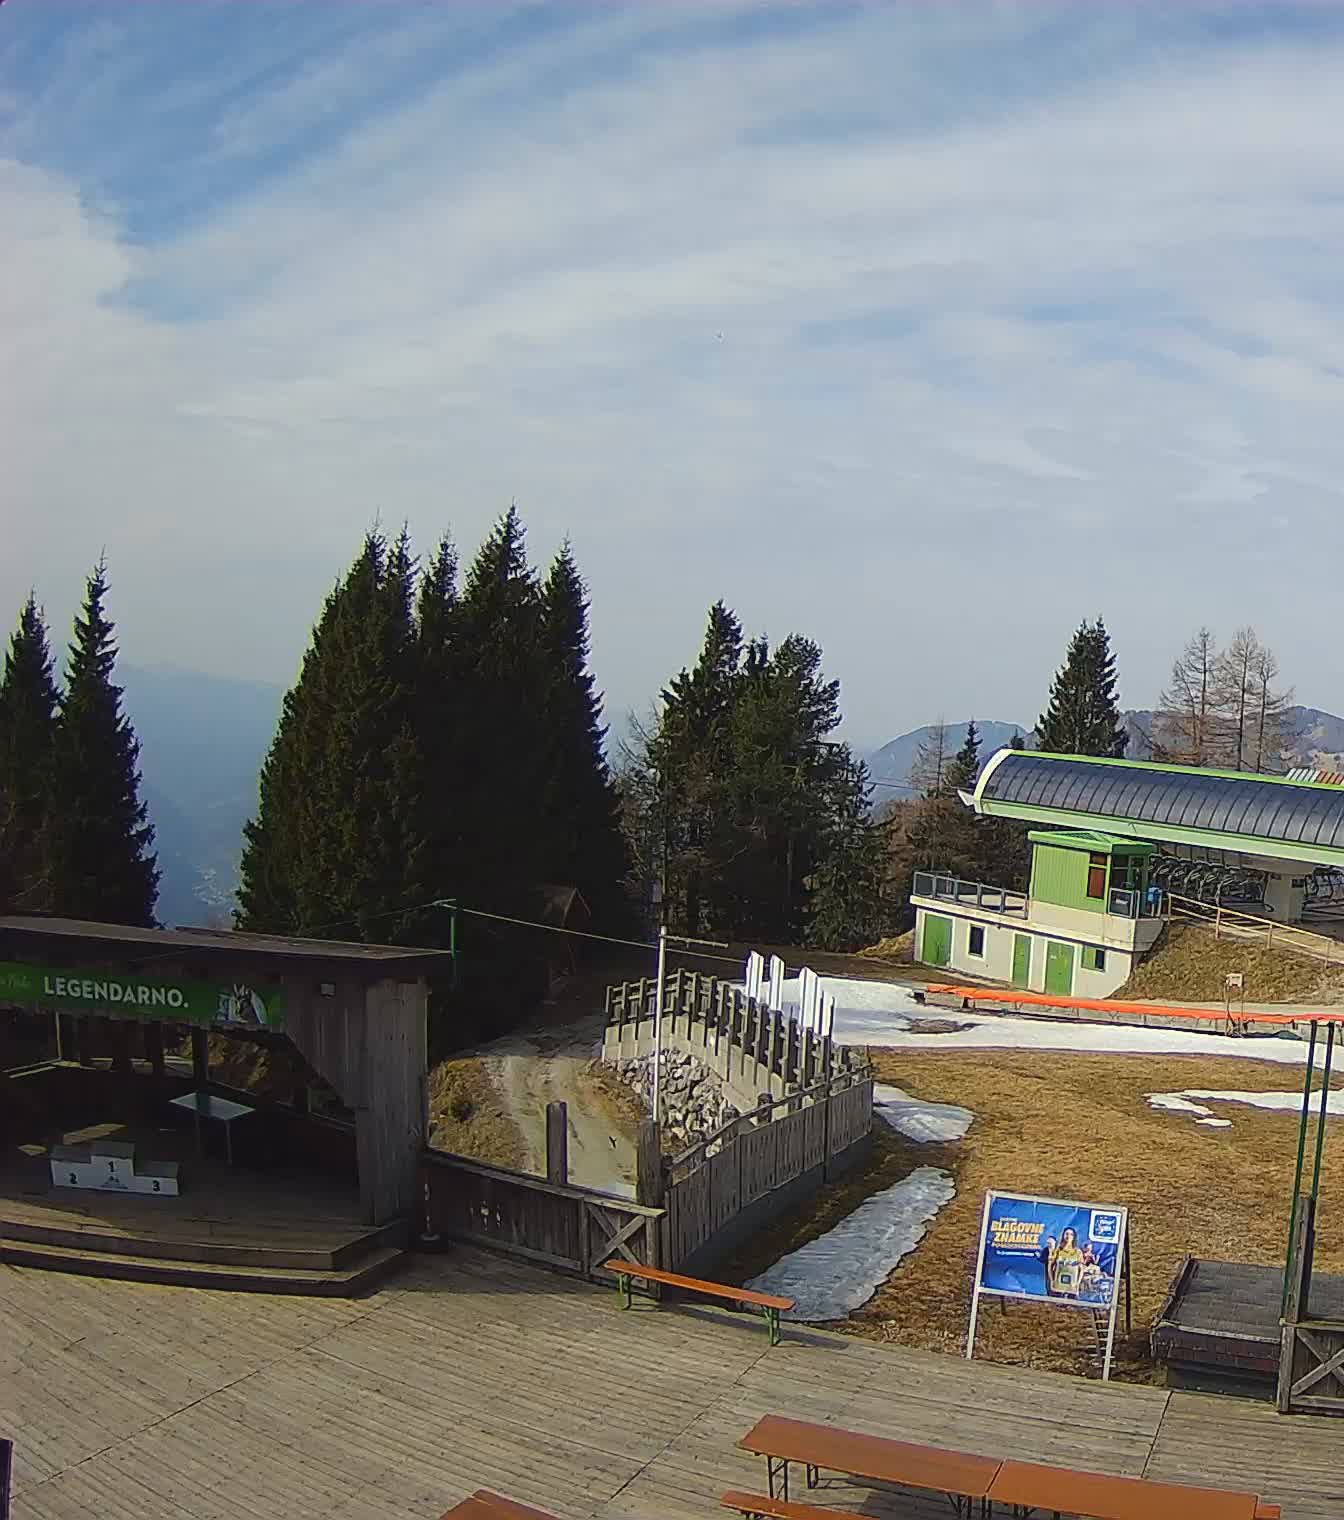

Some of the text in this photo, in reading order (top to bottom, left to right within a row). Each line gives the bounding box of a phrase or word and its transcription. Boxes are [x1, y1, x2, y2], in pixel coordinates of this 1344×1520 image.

[44, 975, 189, 1008] LEGENDARNO.
[108, 1161, 115, 1173] 1
[69, 1173, 77, 1184] 2
[152, 1180, 161, 1192] 3
[991, 1220, 1045, 1234] BLAGOVNE
[993, 1231, 1040, 1244] ZNAMKE
